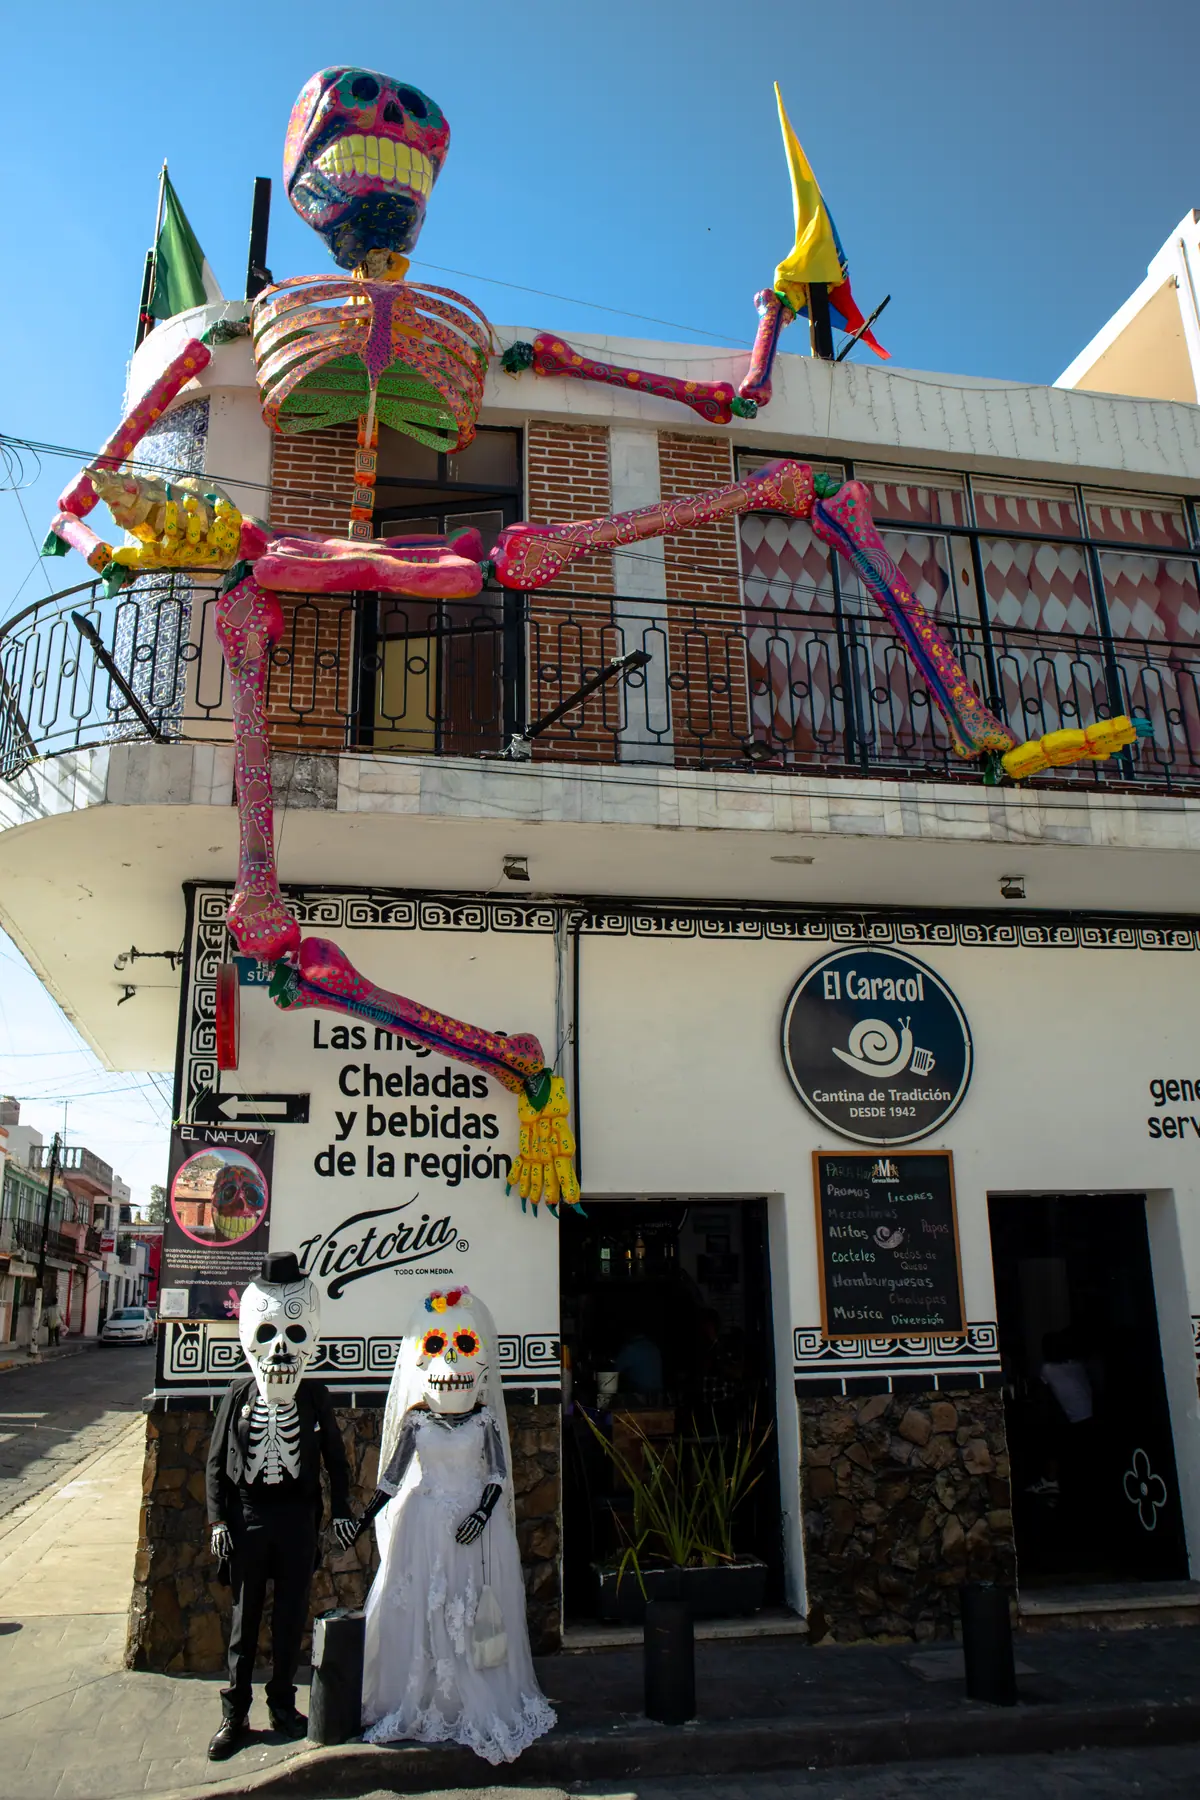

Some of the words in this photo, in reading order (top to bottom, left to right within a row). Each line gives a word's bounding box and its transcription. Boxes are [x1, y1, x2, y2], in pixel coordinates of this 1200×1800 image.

[823, 971, 841, 1000] El
[845, 970, 925, 1002] Caracol
[313, 1020, 367, 1050] Las
[339, 1063, 489, 1098] Cheladas
[812, 1090, 865, 1102] Cantina
[869, 1089, 885, 1101] de
[888, 1088, 951, 1101] Tradición
[335, 1111, 358, 1141] y
[366, 1104, 499, 1139] bebidas
[850, 1107, 886, 1117] DESDE
[889, 1107, 916, 1117] 1942
[181, 1127, 199, 1140] EL
[204, 1129, 263, 1144] NAHUAL
[314, 1144, 356, 1177] de
[367, 1145, 394, 1177] la
[404, 1144, 512, 1187] región
[827, 1184, 871, 1199] PROMOS
[829, 1225, 869, 1240] Alitas
[299, 1192, 458, 1300] Victoria
[832, 1272, 934, 1291] Hamburguesas
